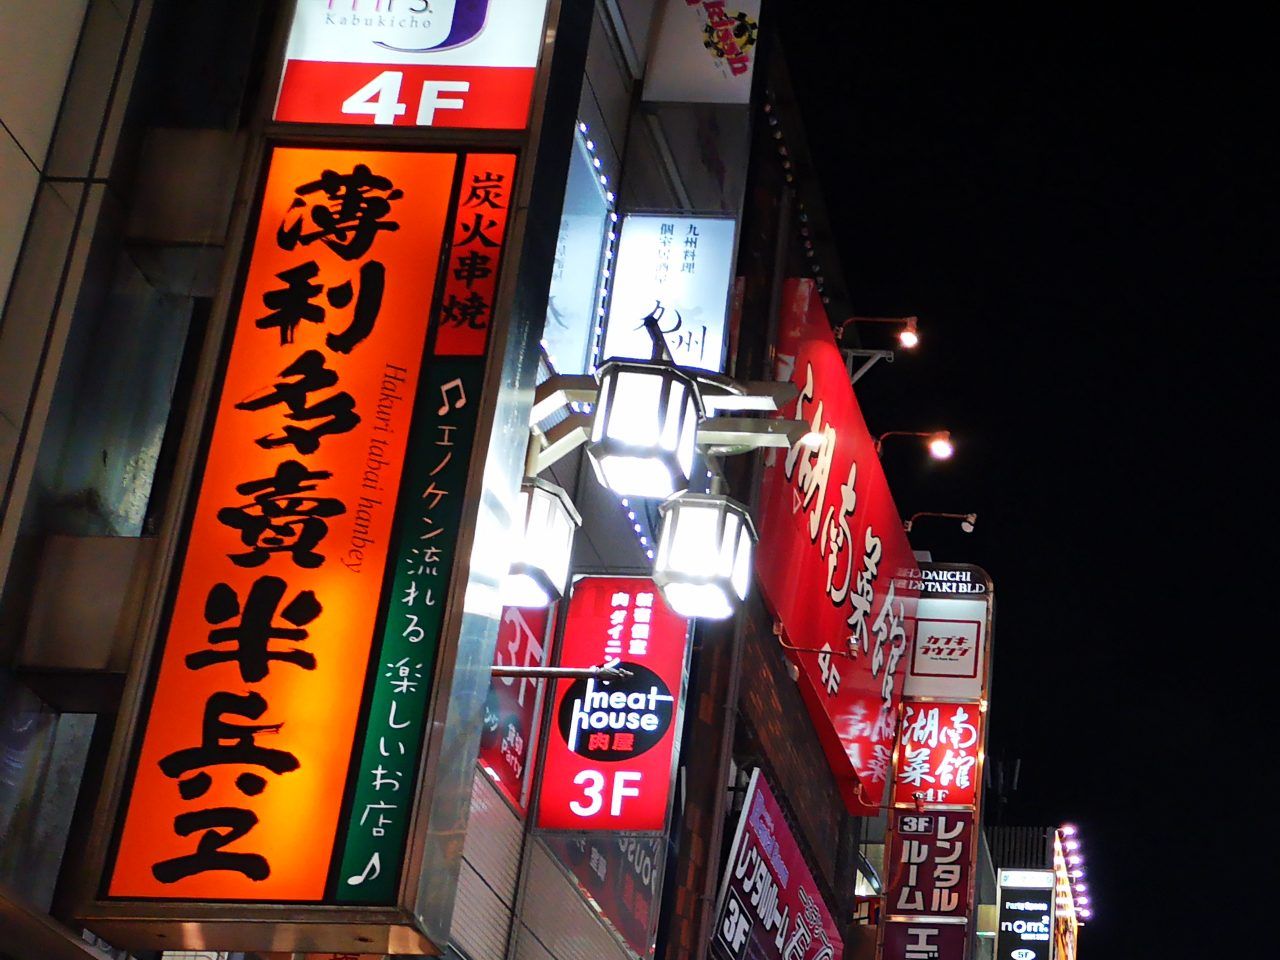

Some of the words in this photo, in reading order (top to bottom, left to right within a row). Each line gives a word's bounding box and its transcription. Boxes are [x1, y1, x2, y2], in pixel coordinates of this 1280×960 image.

[324, 14, 433, 30] Kabukicho
[341, 70, 471, 126] 4F
[439, 170, 510, 332] 炭火串焼
[681, 222, 701, 275] 九州料理
[376, 362, 408, 434] Hakuri
[363, 438, 393, 511] tabai
[341, 517, 382, 574] hanbey
[926, 635, 969, 646] カブキ
[817, 641, 842, 695] 4F
[587, 680, 674, 711] meat
[568, 698, 660, 753] house
[588, 732, 634, 751] 肉屋
[900, 705, 978, 749] 湖南
[568, 768, 642, 817] 3F
[899, 748, 977, 791] 菜館
[902, 816, 930, 832] 3F
[896, 839, 929, 912] ルーム
[931, 815, 966, 912] レンタル
[722, 898, 750, 948] 3F
